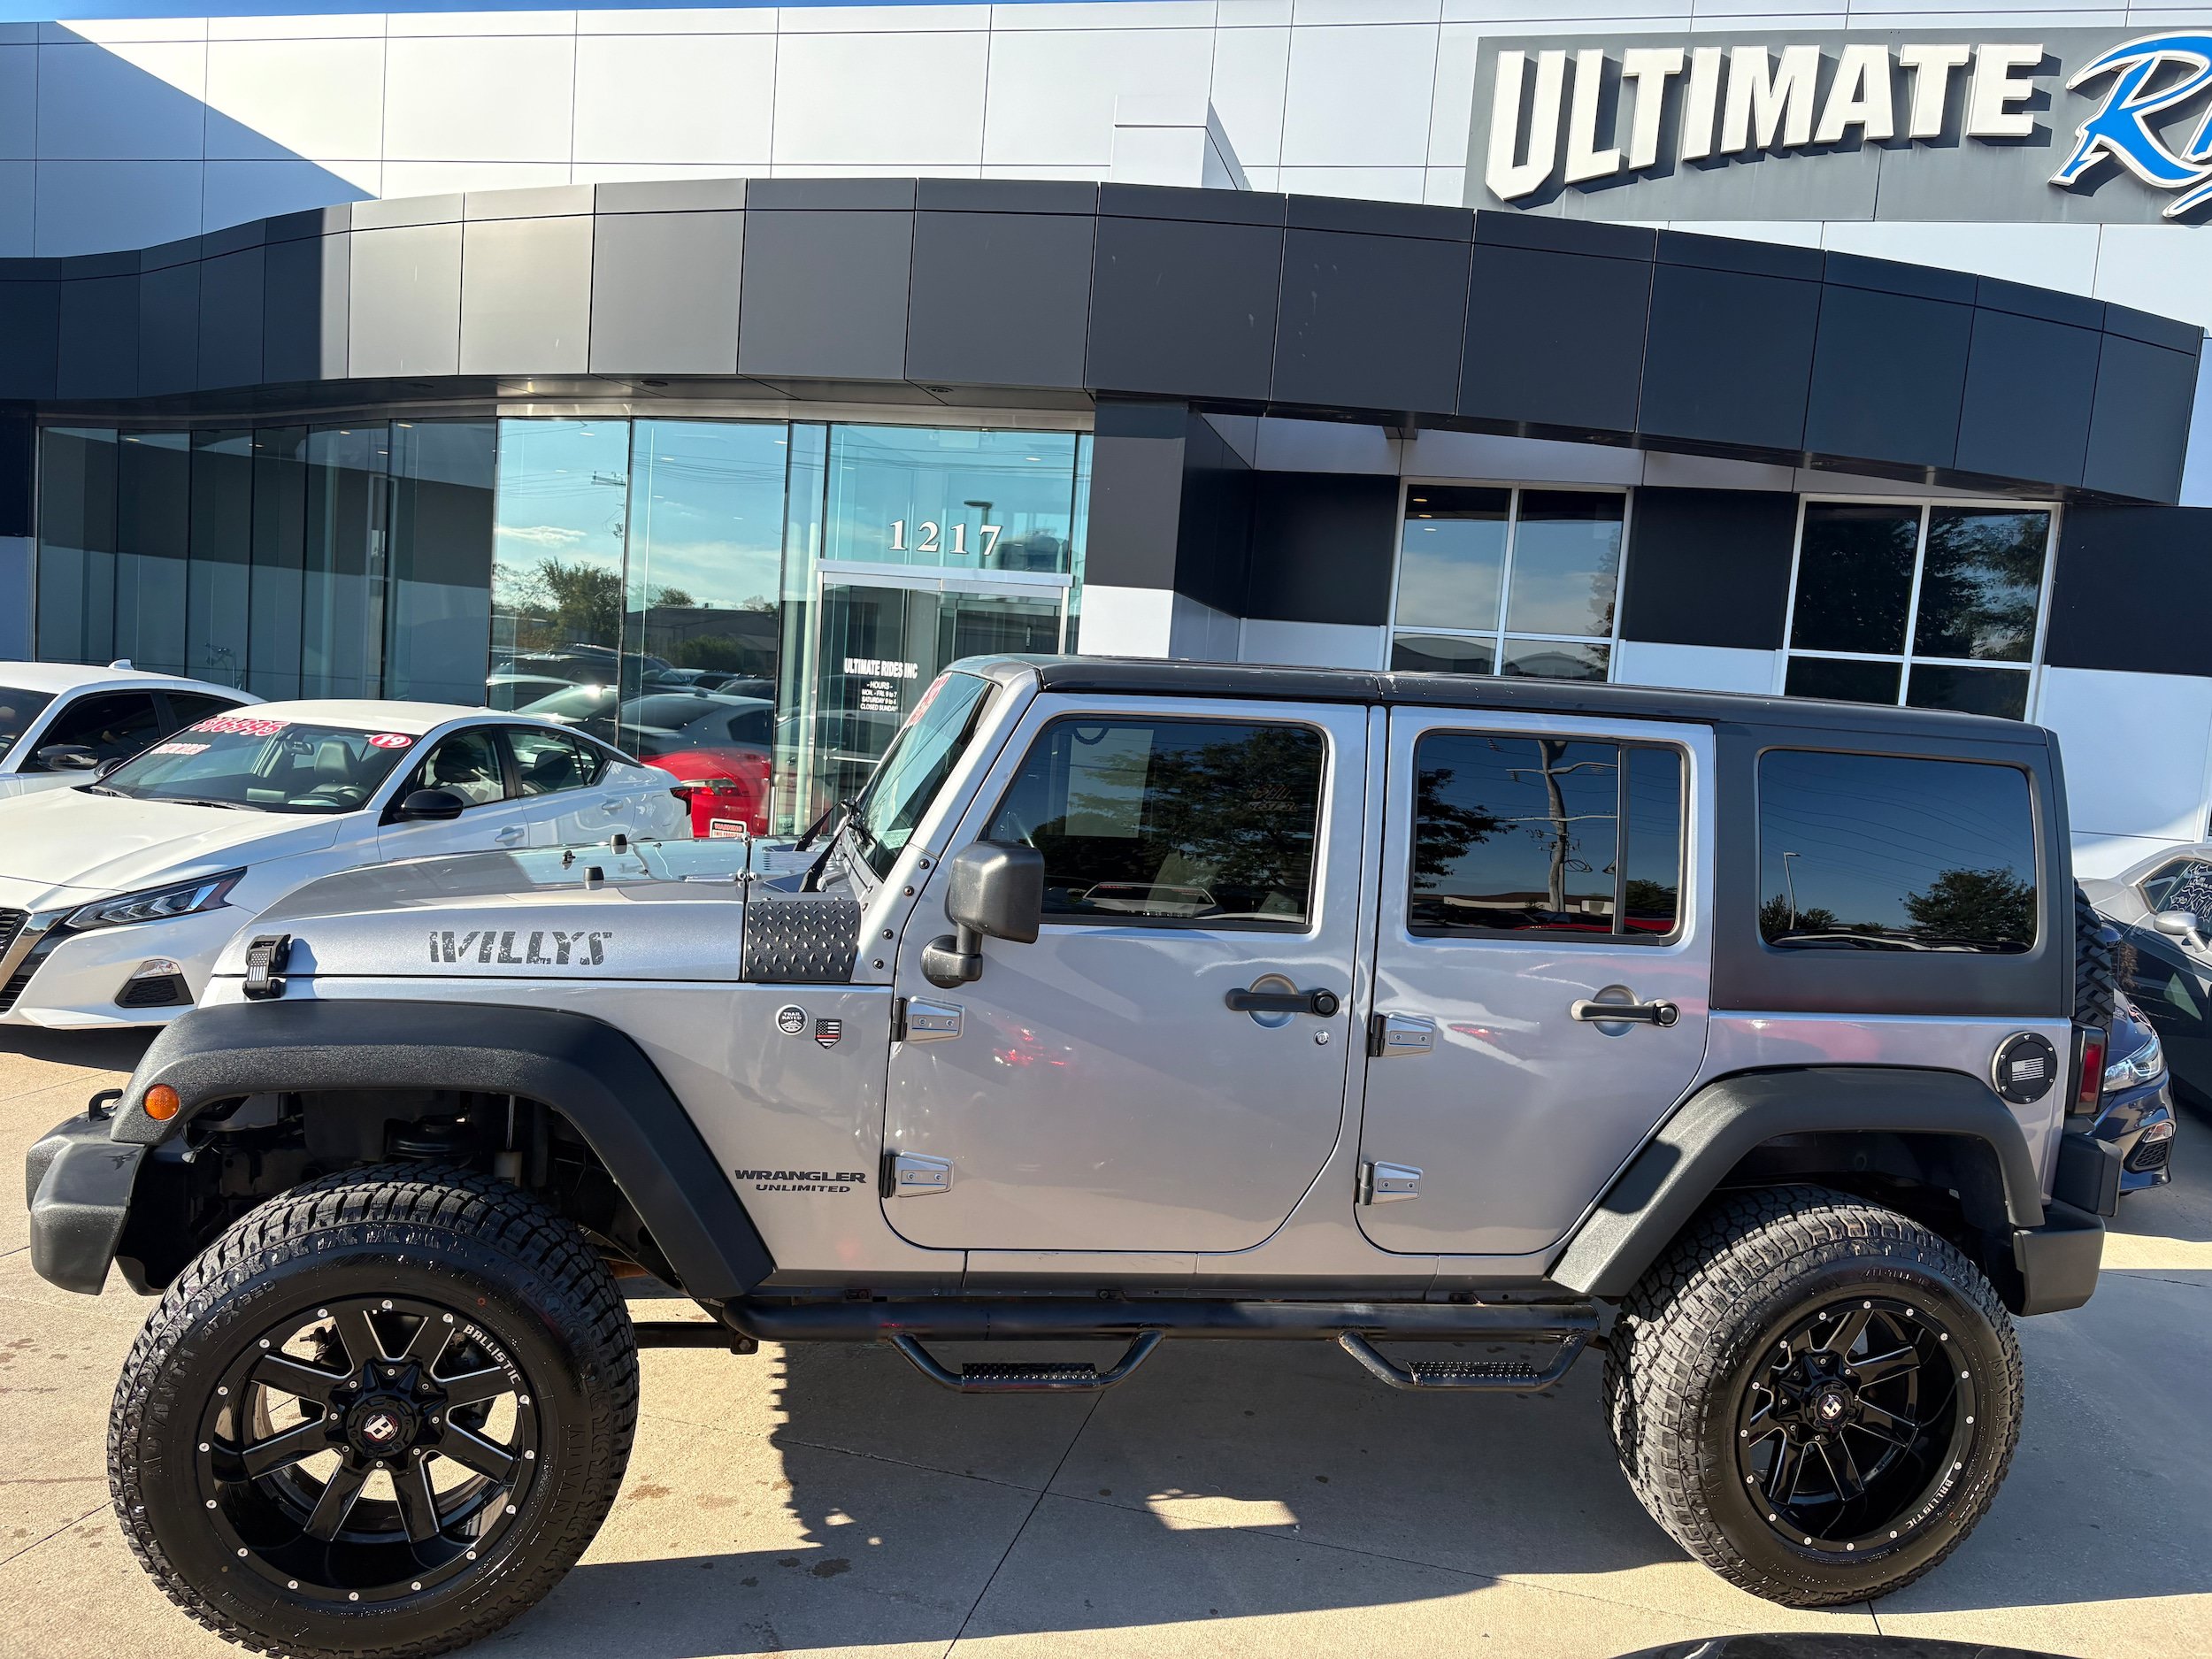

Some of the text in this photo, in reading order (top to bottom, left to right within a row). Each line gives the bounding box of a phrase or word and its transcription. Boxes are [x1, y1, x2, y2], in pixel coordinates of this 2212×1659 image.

[1486, 44, 2043, 201] ULTIMATE
[888, 519, 1002, 556] 1217
[844, 657, 918, 680] ULTIMATE RIDES INC
[870, 680, 890, 690] HOURS
[375, 734, 408, 747] 19
[428, 931, 613, 965] WILLYS
[734, 1170, 867, 1184] WRANGLER
[756, 1184, 851, 1193] UNLIMITED
[462, 1324, 521, 1385] BALLISTIC
[1905, 1479, 1954, 1530] BALLISTIC
